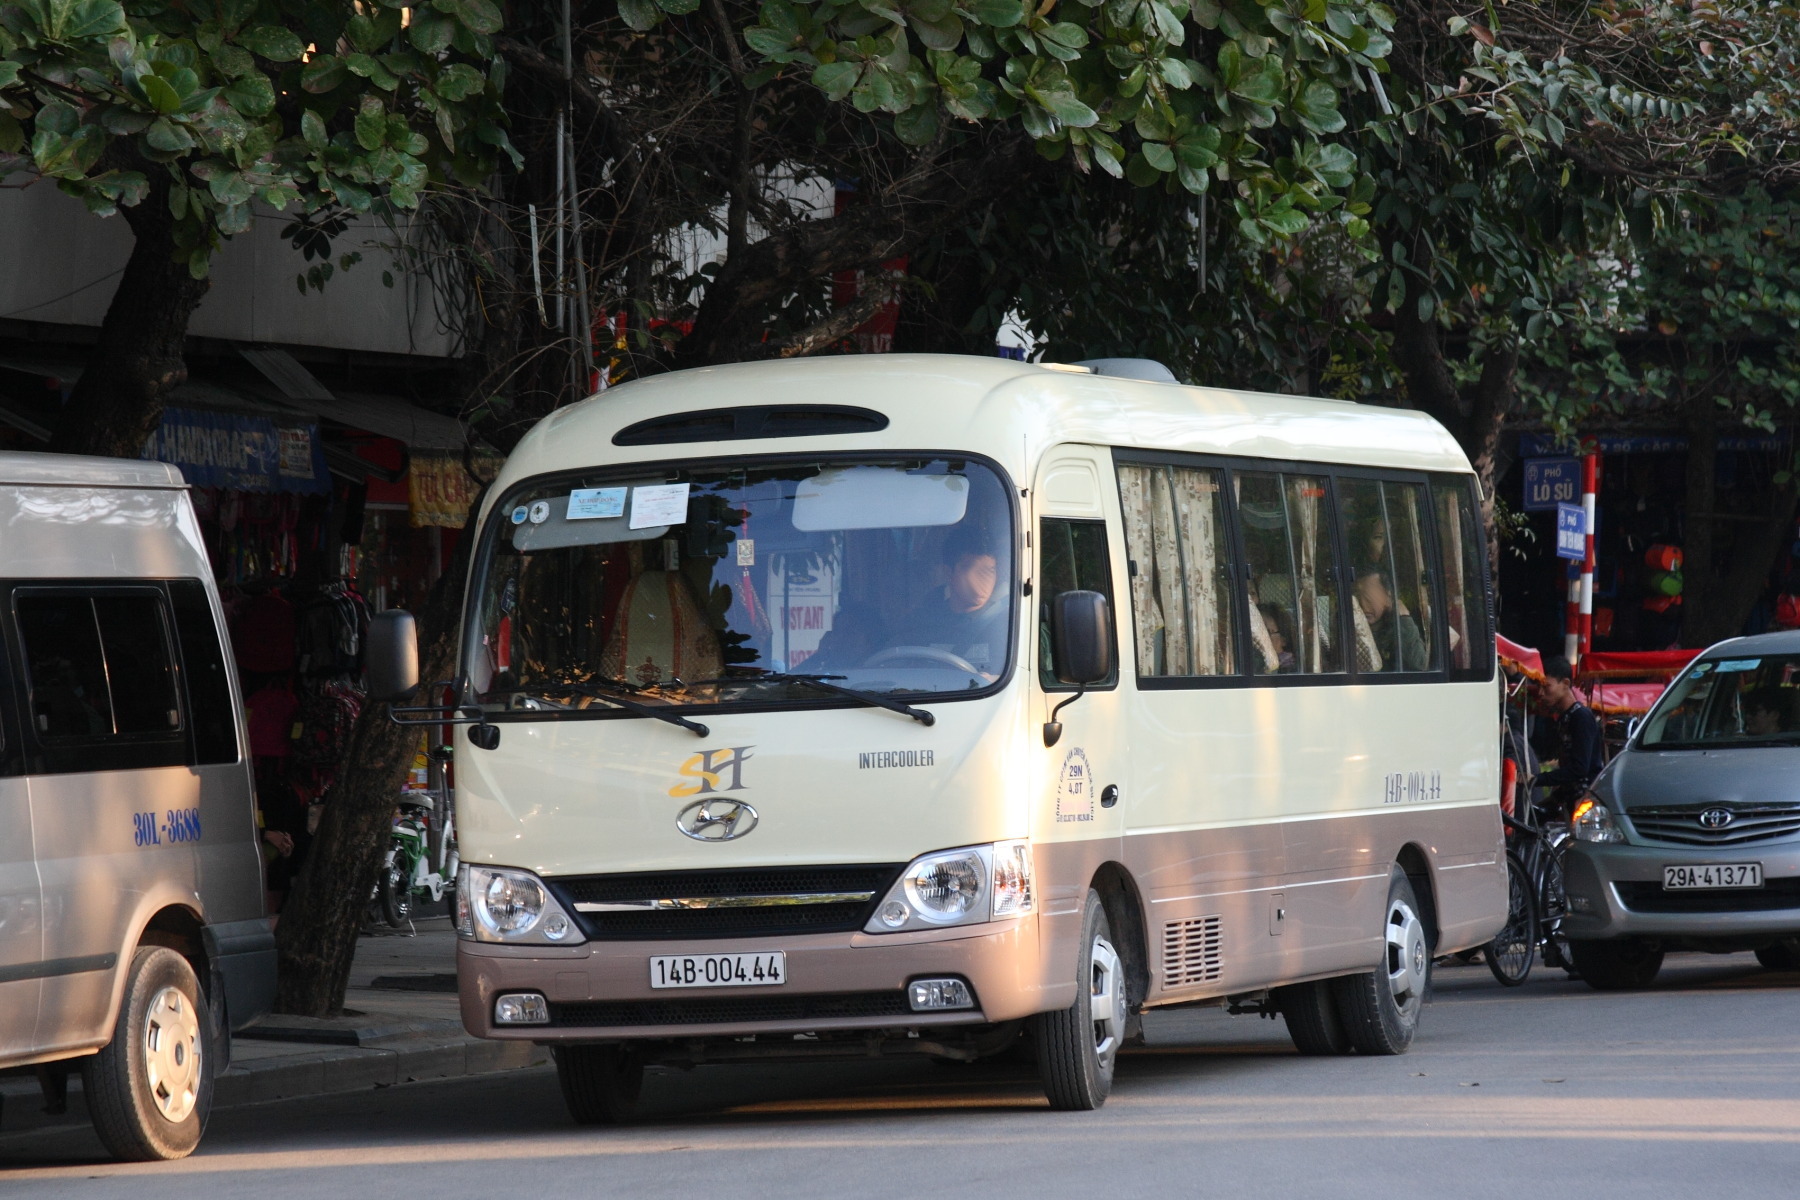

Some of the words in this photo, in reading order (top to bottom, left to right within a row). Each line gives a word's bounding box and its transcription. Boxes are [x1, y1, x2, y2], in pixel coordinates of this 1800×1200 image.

[1544, 464, 1562, 477] PHỐ
[1533, 479, 1551, 502] LÒ
[1554, 478, 1573, 500] SŨ
[859, 749, 934, 769] INTERCOOLER
[1069, 765, 1083, 777] 29N
[133, 807, 201, 847] 30L-3688
[1666, 866, 1757, 887] 29A-413.71
[657, 956, 780, 985] 14B-004.44
